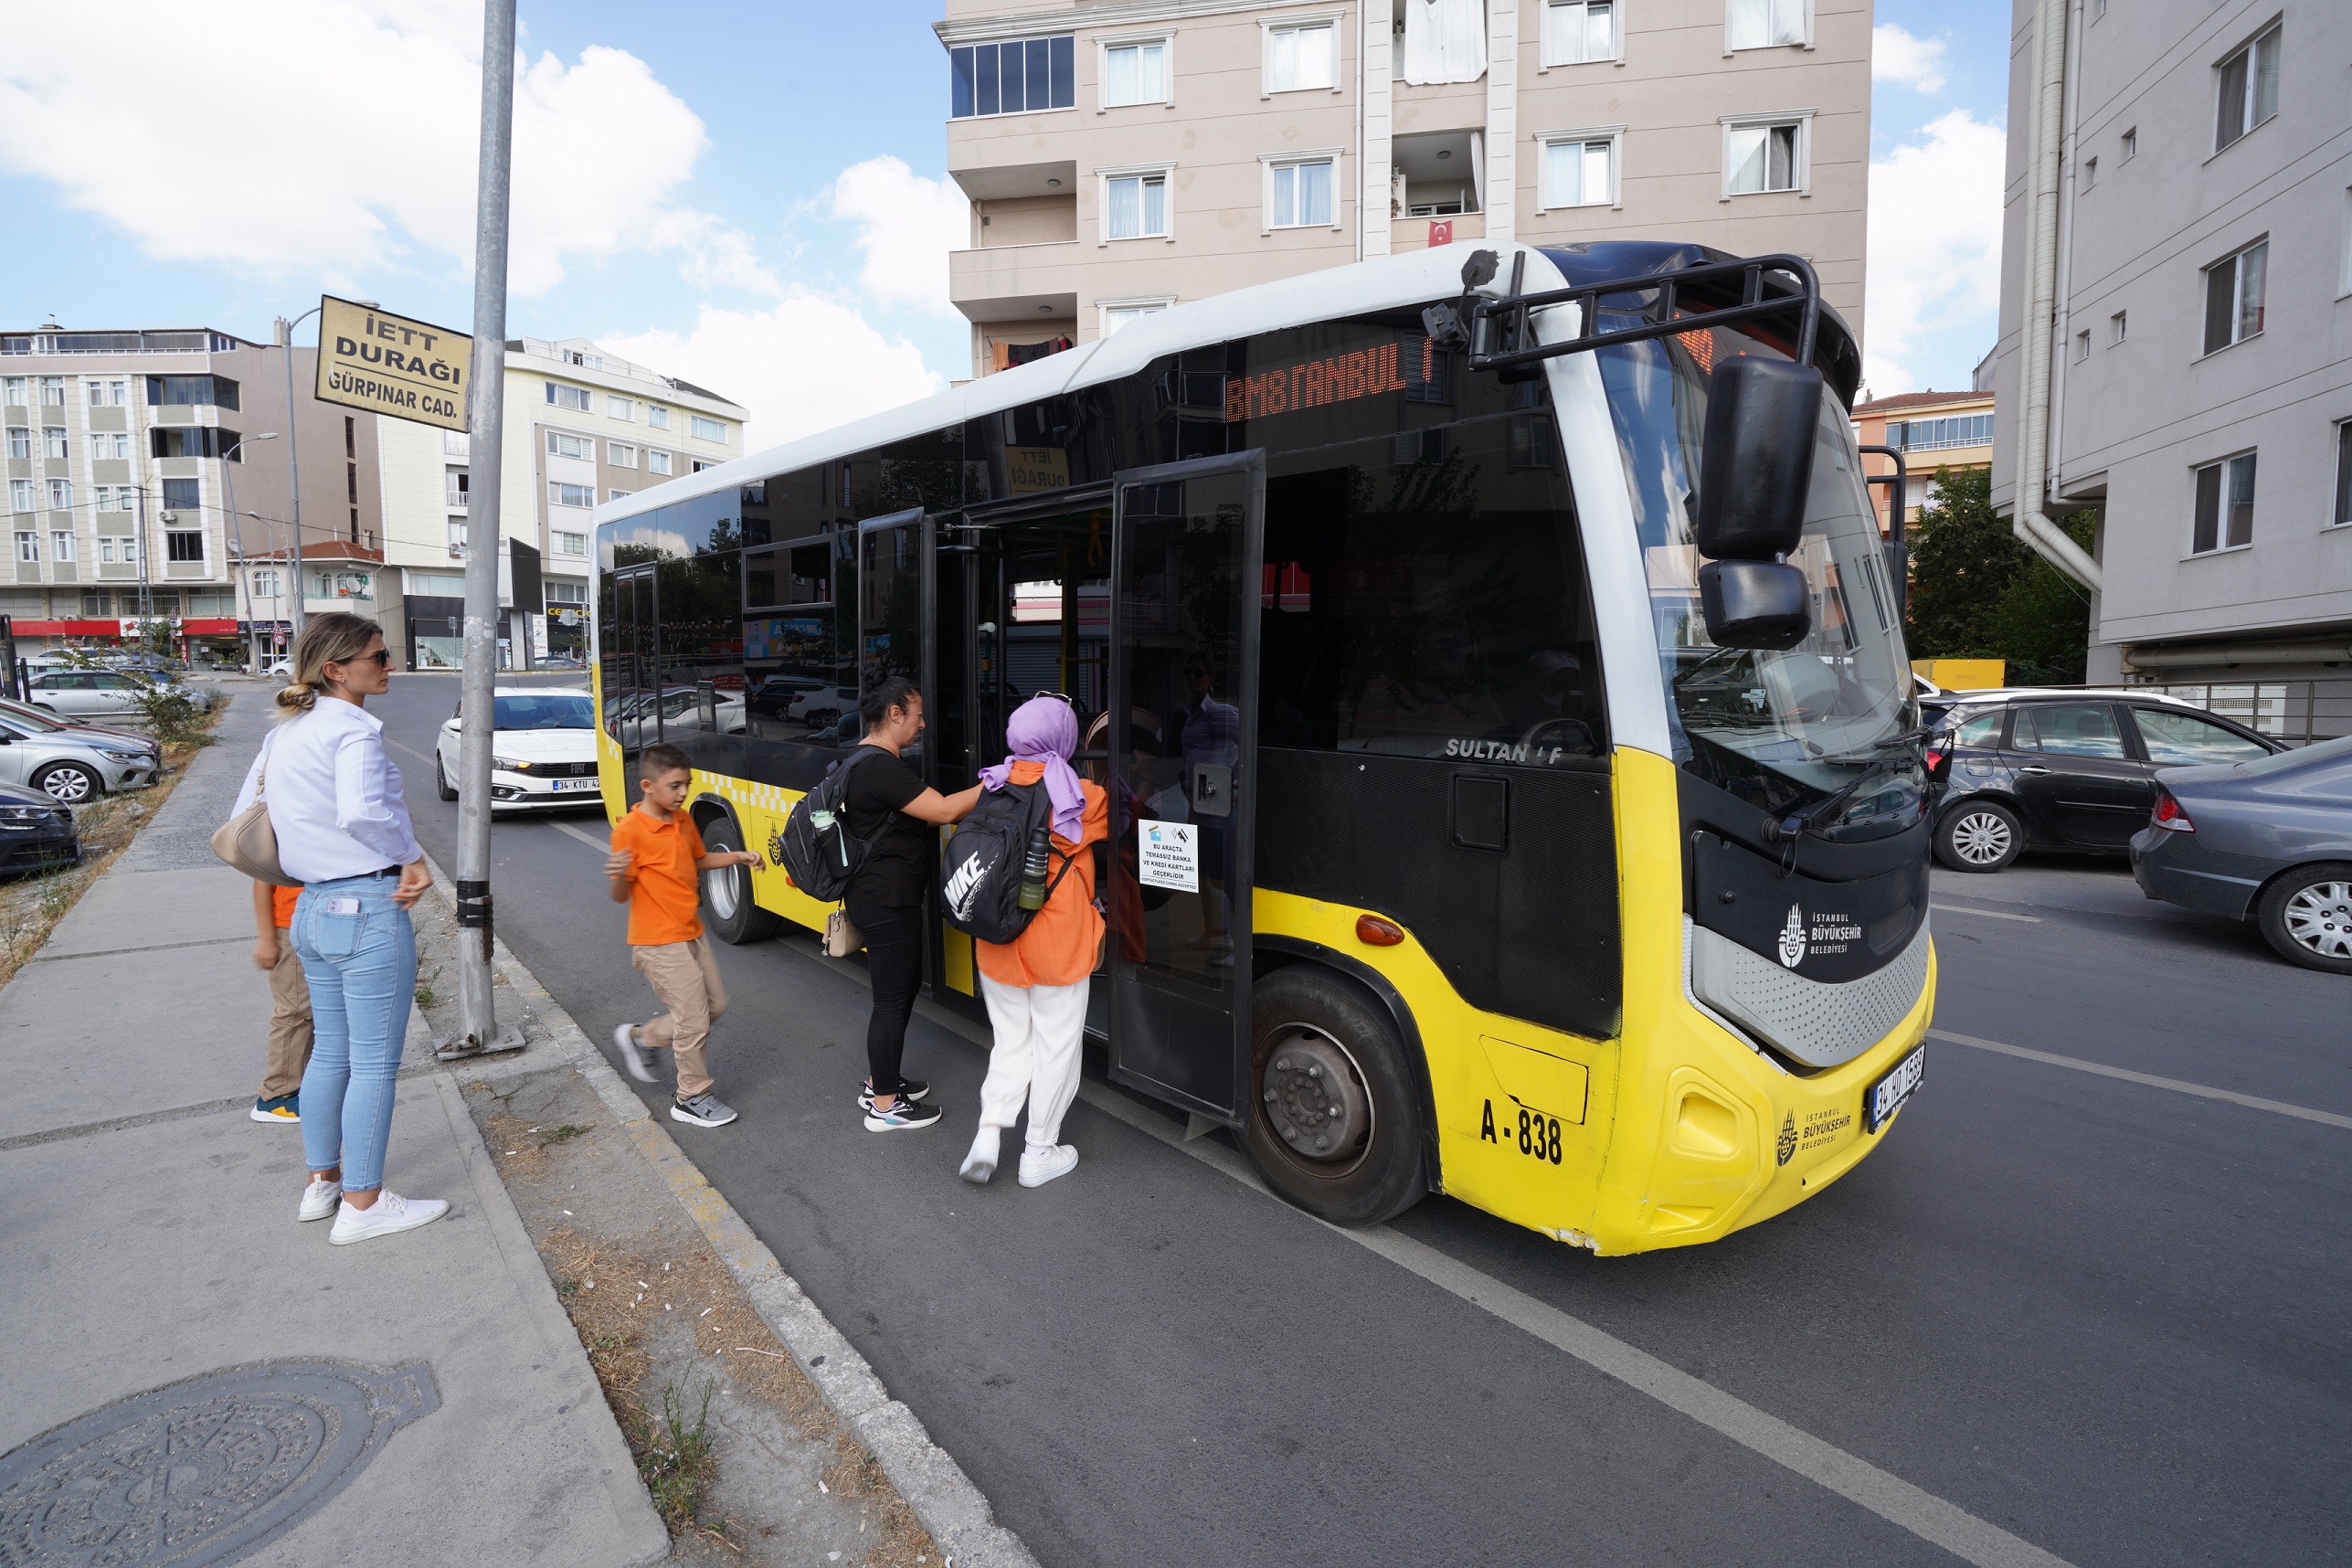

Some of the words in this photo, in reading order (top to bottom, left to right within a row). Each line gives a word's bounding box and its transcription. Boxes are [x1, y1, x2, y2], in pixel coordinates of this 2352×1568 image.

[366, 313, 439, 352] İETT
[335, 336, 460, 385] DURAĞI
[328, 371, 417, 409] GÜRPINAR
[421, 395, 457, 418] CAD.
[1446, 738, 1531, 762] SULTAN
[570, 763, 586, 774] FIAT
[559, 781, 568, 789] 34
[573, 780, 588, 789] KTU
[1146, 852, 1171, 860] TEMASSIZ
[1172, 854, 1192, 863] BANKA
[1152, 870, 1183, 879] GEÇERLİDİR
[1168, 863, 1194, 872] KARTLARI
[944, 850, 985, 912] NIKE
[1812, 912, 1849, 922] İSTANBUL
[1811, 924, 1861, 941] BÜYÜKŞEHİR
[1810, 943, 1847, 954] BELEDİYESİ
[1877, 1083, 1888, 1115] 34
[1806, 1107, 1840, 1122] İSTANBUL
[1804, 1114, 1851, 1139] BÜYÜKŞEHİR
[1801, 1133, 1837, 1150] BELEDİYESİ
